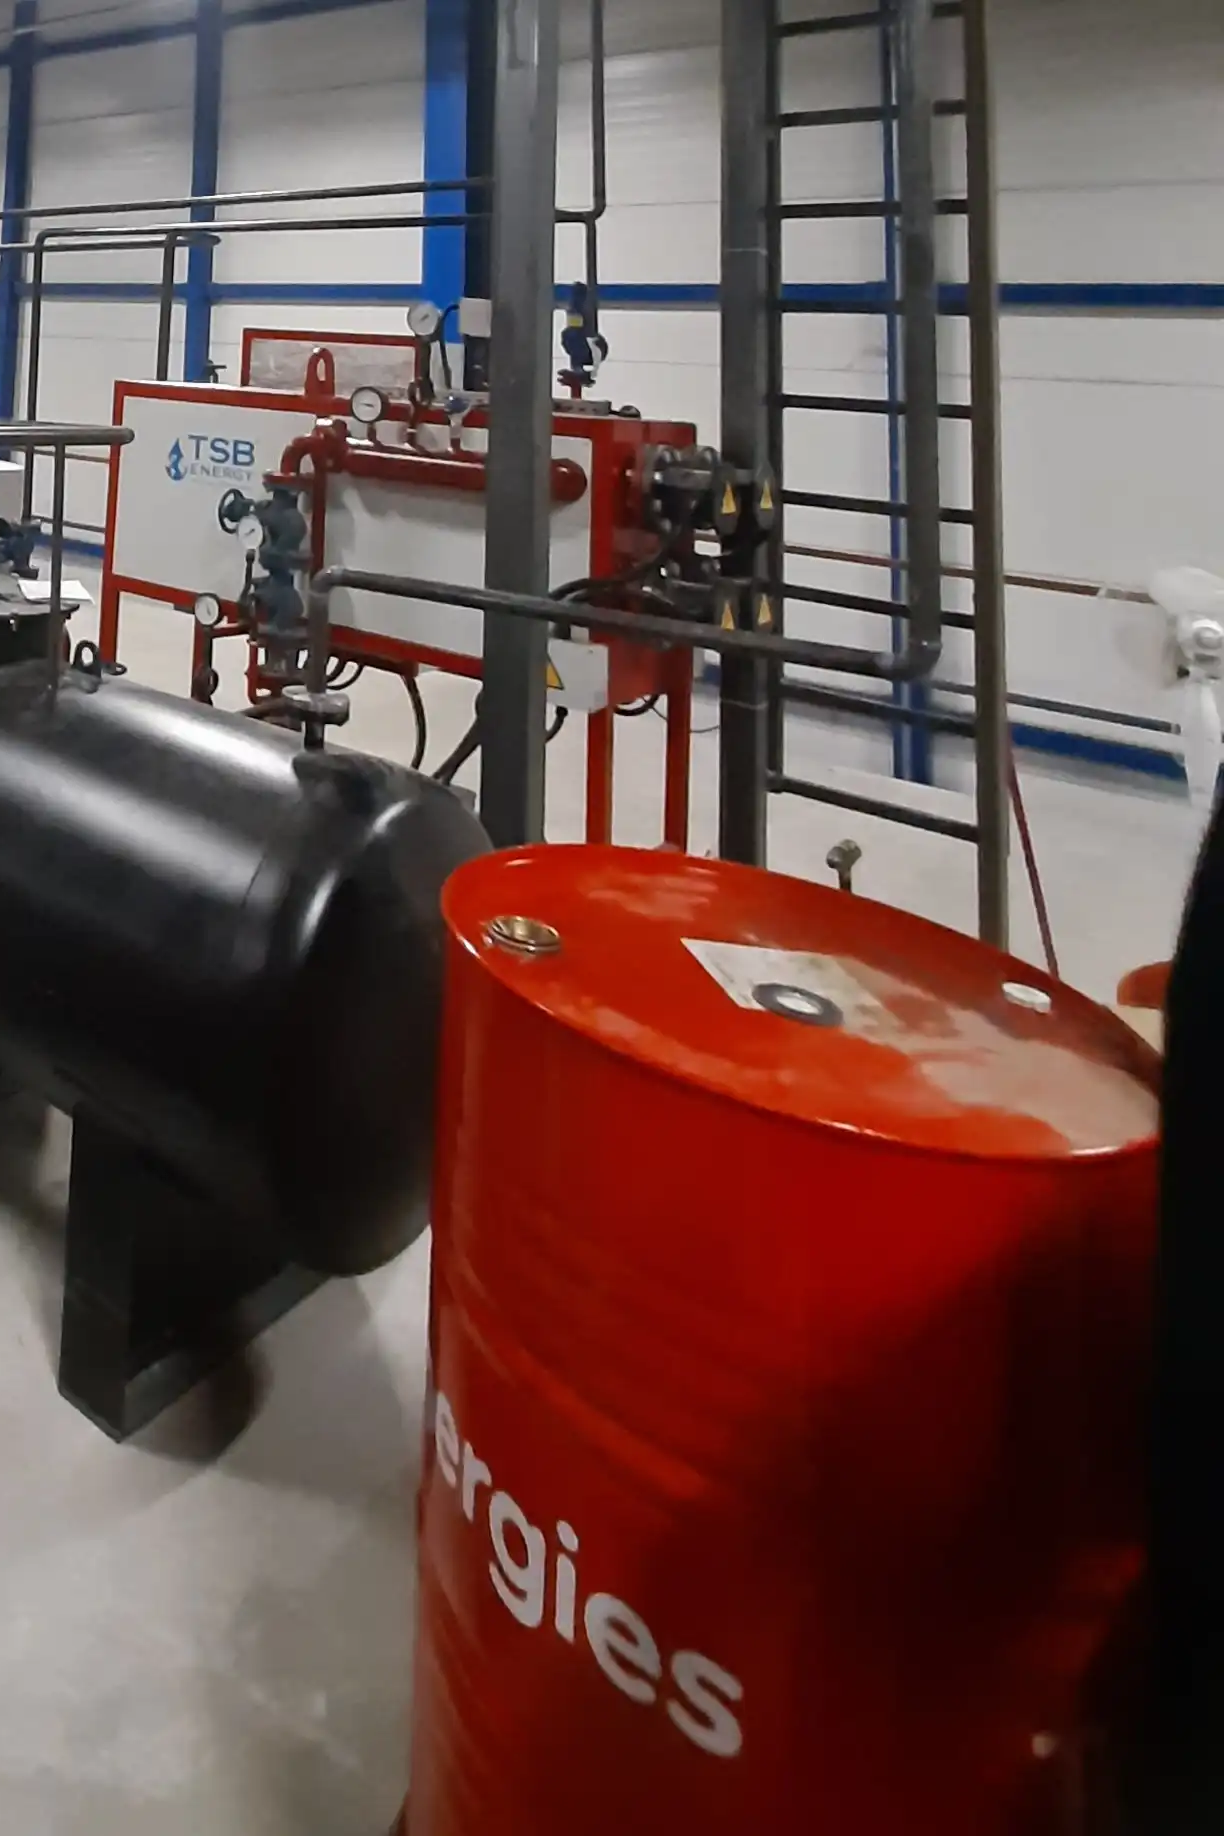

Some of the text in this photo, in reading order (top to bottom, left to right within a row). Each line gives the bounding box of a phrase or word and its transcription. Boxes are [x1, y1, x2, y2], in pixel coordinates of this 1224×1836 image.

[187, 434, 255, 467] TSB
[190, 462, 253, 481] ENERGY
[434, 1390, 744, 1758] ergies
